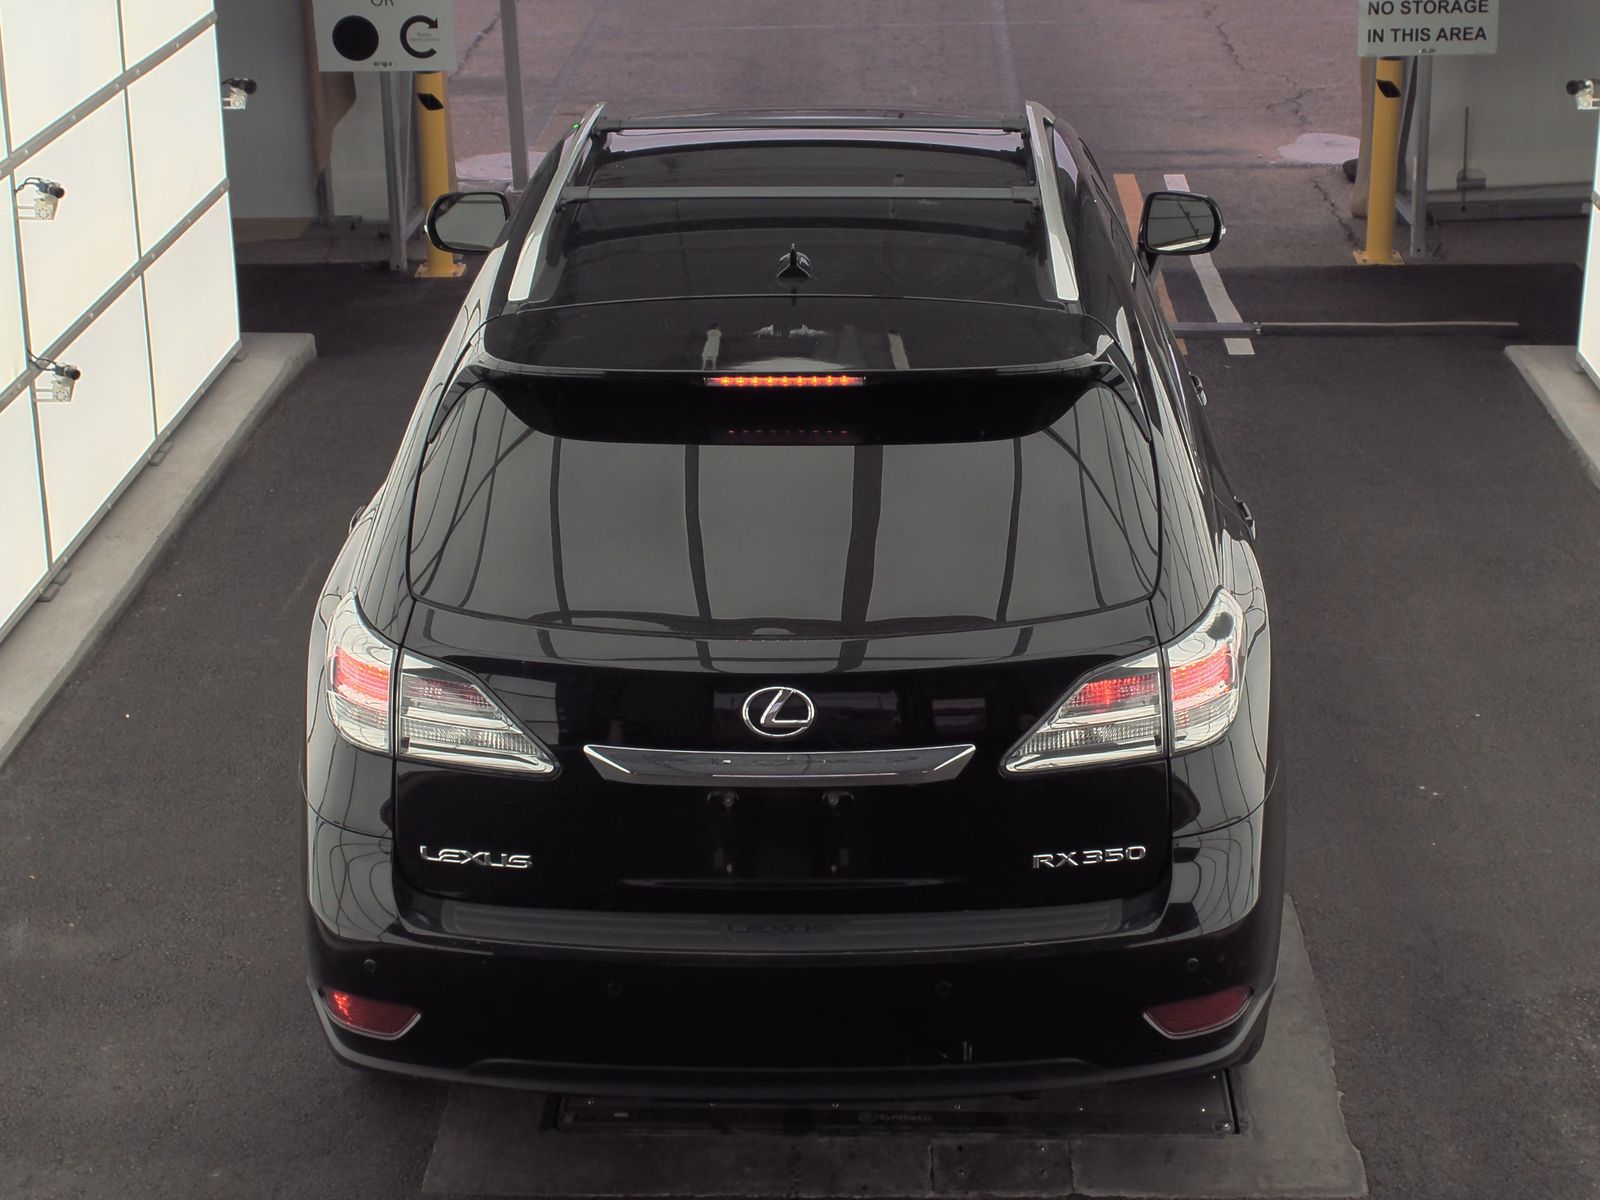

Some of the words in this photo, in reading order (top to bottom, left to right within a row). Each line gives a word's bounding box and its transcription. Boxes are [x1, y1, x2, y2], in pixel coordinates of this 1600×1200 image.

[1368, 1, 1394, 15] NO
[1400, 0, 1489, 14] STORAGE
[1367, 29, 1384, 42] IN
[1391, 28, 1430, 42] THIS
[1436, 26, 1487, 41] AREA
[420, 845, 533, 868] LEXUS
